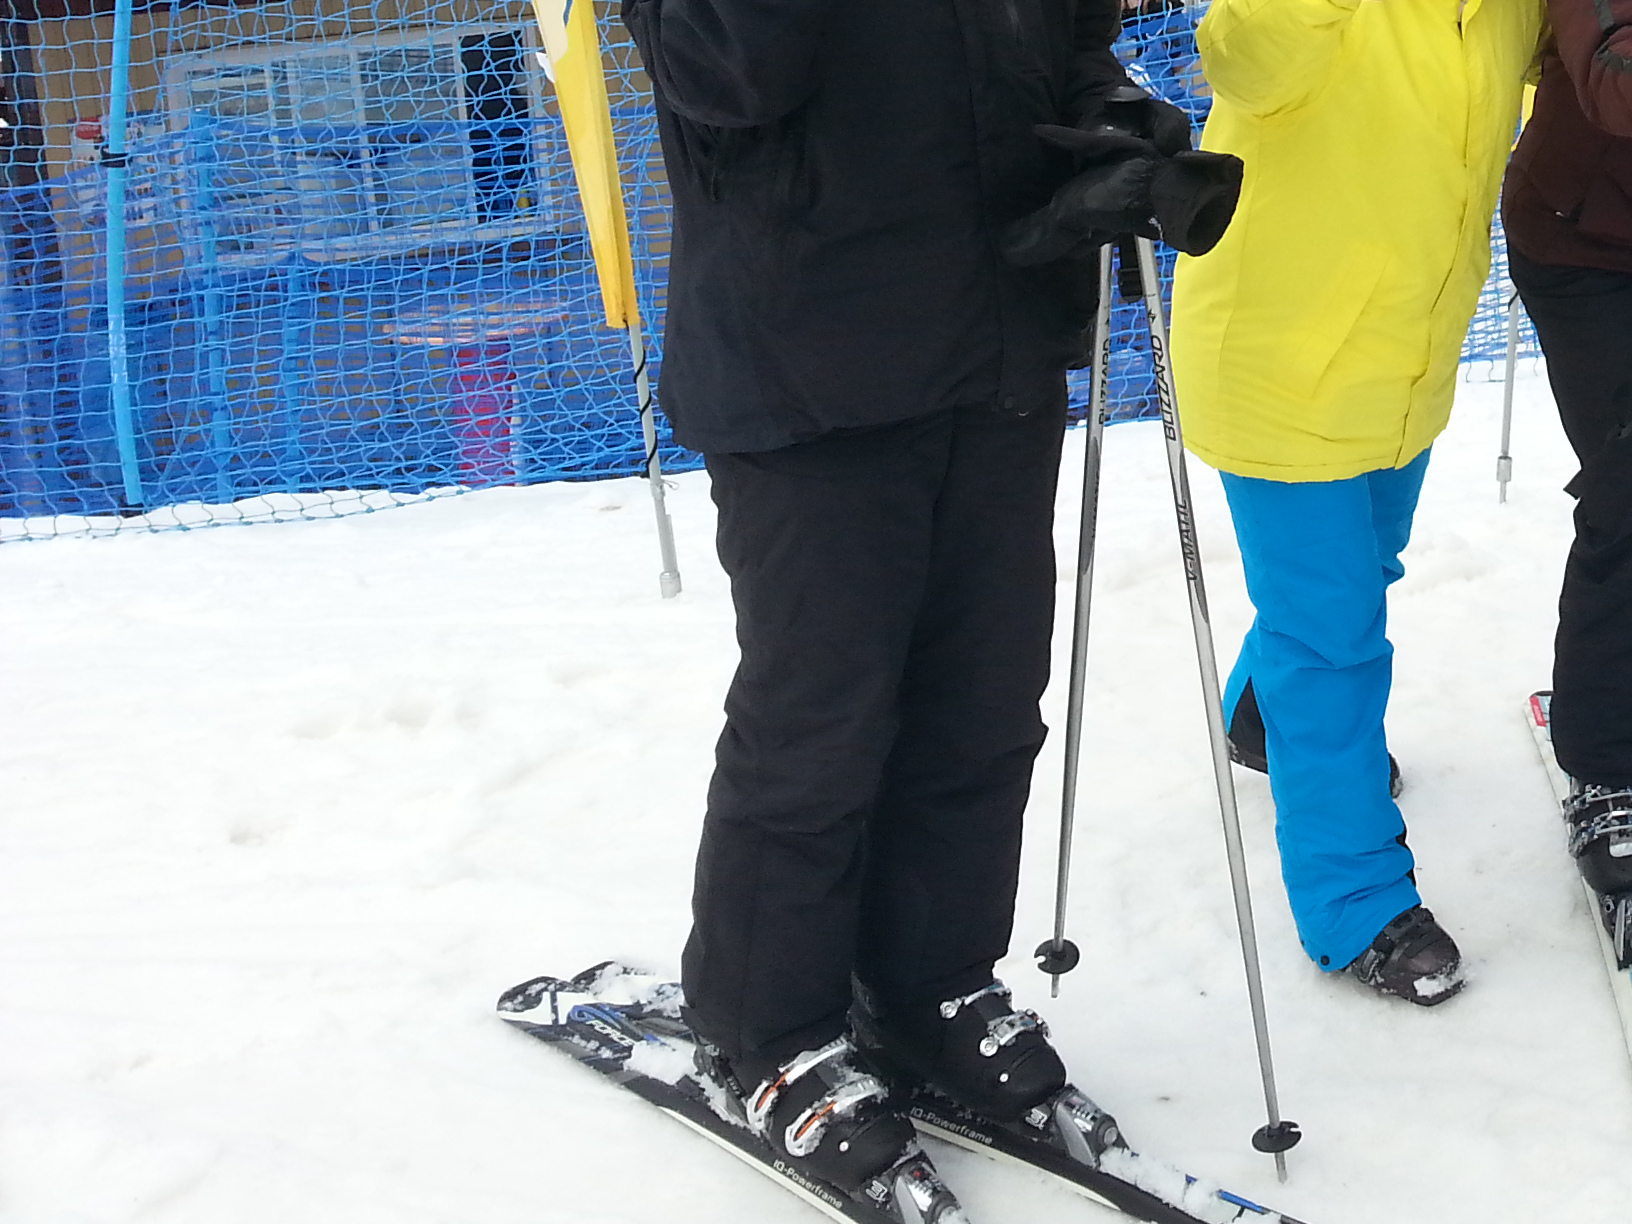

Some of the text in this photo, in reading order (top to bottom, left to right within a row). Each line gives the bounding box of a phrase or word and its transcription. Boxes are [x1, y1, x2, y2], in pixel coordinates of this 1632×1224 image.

[585, 1019, 637, 1048] FORCE
[910, 1106, 993, 1145] IQ-Powerframe
[773, 1159, 843, 1209] IQ-Powerframe
